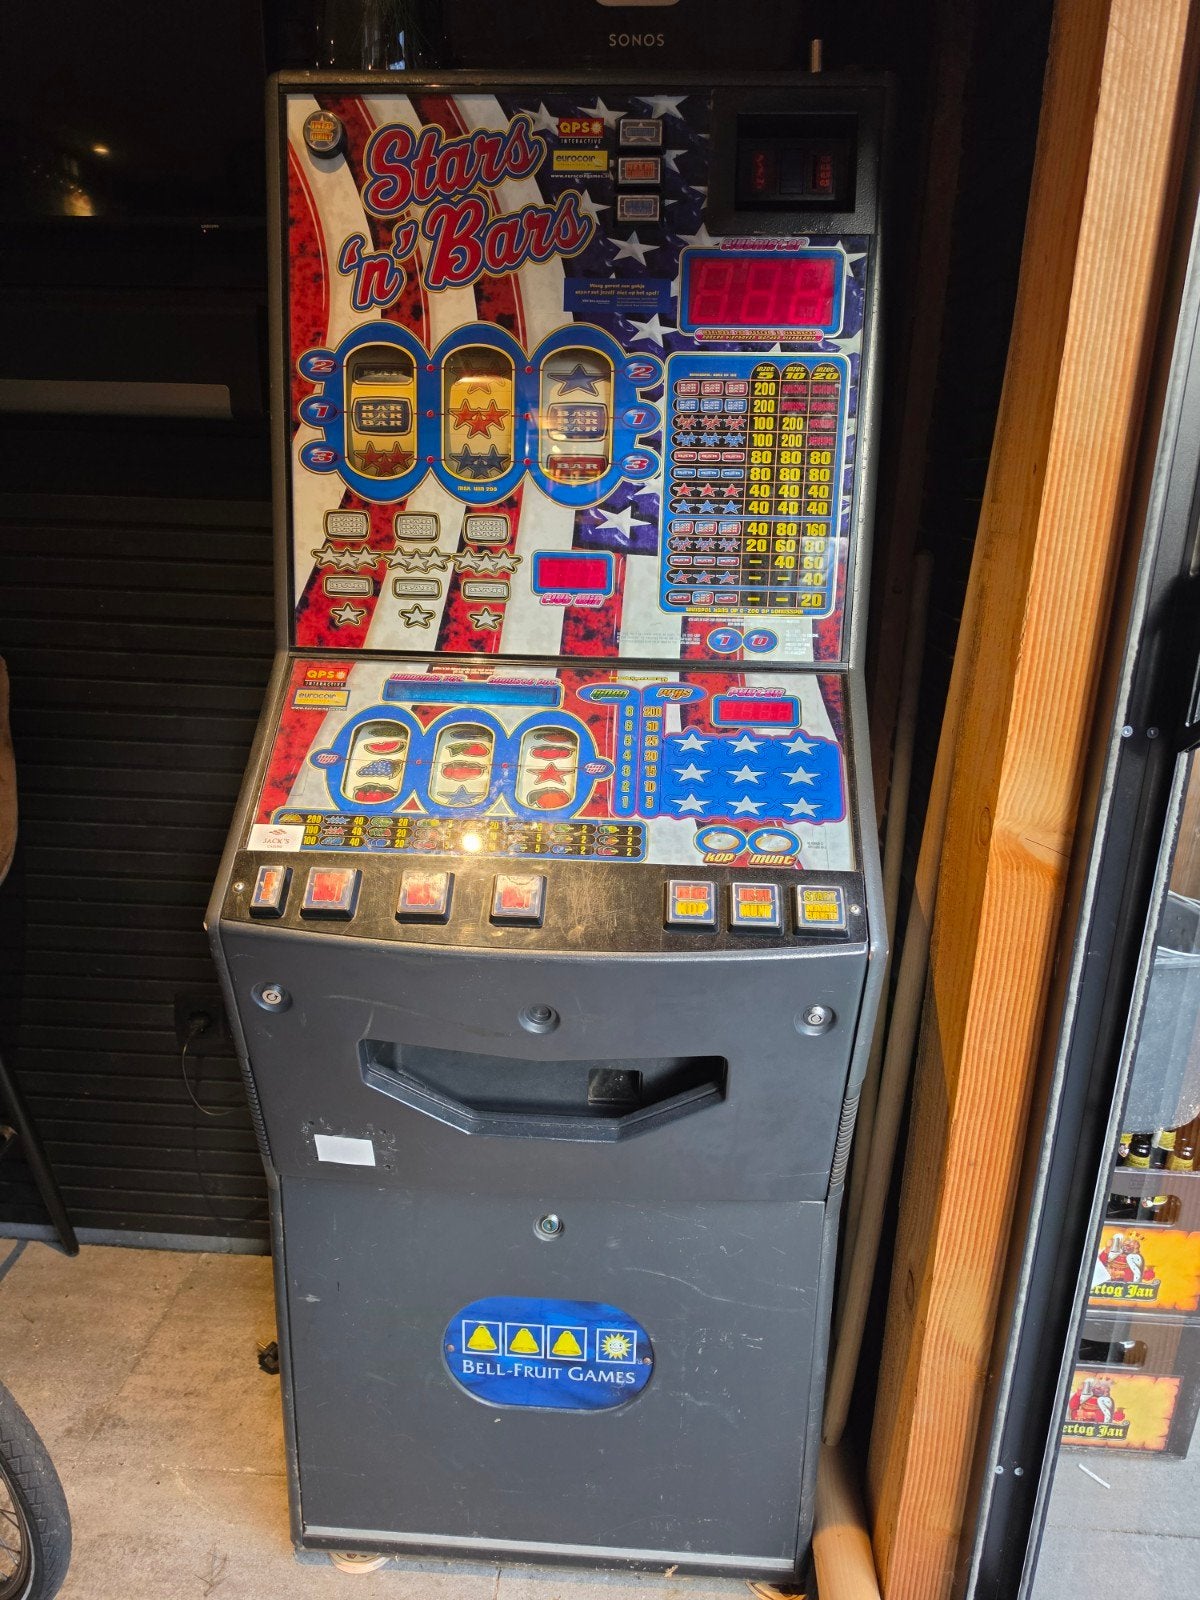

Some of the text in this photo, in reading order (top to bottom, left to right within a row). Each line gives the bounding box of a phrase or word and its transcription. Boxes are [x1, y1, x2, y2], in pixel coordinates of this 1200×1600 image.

[609, 34, 664, 46] SONOS
[560, 121, 590, 133] QPS
[363, 116, 545, 215] Stars
[423, 197, 592, 289] Bars
[308, 359, 334, 373] 2
[628, 365, 653, 379] 2
[786, 372, 806, 380] 10
[754, 382, 776, 396] 200
[314, 406, 330, 418] 1
[753, 399, 775, 413] 200
[632, 412, 647, 424] 1
[753, 416, 774, 431] 100
[782, 416, 804, 431] 200
[752, 434, 773, 447] 100
[781, 434, 803, 448] 200
[310, 451, 334, 463] 3
[629, 457, 651, 470] 3
[751, 450, 772, 464] 80
[780, 451, 802, 465] 80
[809, 451, 831, 465] 80
[750, 467, 771, 481] 80
[779, 468, 801, 481] 80
[809, 468, 830, 482] 80
[749, 484, 829, 498] 40 40 40
[748, 501, 828, 515] 40 40 40
[747, 522, 769, 536] 40
[776, 522, 797, 536] 80
[806, 523, 827, 536] 160
[746, 539, 825, 553] 20 60 80
[774, 555, 825, 570] 40 60
[802, 572, 824, 586] 40
[575, 594, 604, 606] win
[801, 593, 822, 607] 20
[720, 636, 730, 645] 1
[307, 669, 335, 679] QPS
[643, 706, 662, 717] 200
[645, 735, 658, 746] 25
[645, 750, 658, 762] 20
[646, 765, 656, 777] 15
[622, 780, 656, 792] 2 10
[645, 796, 654, 808] 5
[307, 815, 321, 823] 200
[354, 817, 364, 825] 40
[398, 818, 408, 826] 20
[582, 825, 587, 833] 2
[627, 827, 633, 835] 2
[305, 825, 318, 833] 100
[352, 827, 362, 835] 40
[396, 829, 407, 837] 20
[581, 836, 586, 844] 2
[627, 837, 632, 845] 2
[304, 835, 316, 844] 100
[350, 838, 360, 846] 40
[394, 839, 405, 848] 20
[580, 846, 586, 854] 2
[626, 848, 632, 856] 2
[675, 901, 708, 917] KOP
[1090, 1284, 1155, 1298] rtog Jan
[568, 1366, 636, 1384] GAMES
[1097, 1424, 1124, 1438] Jan
